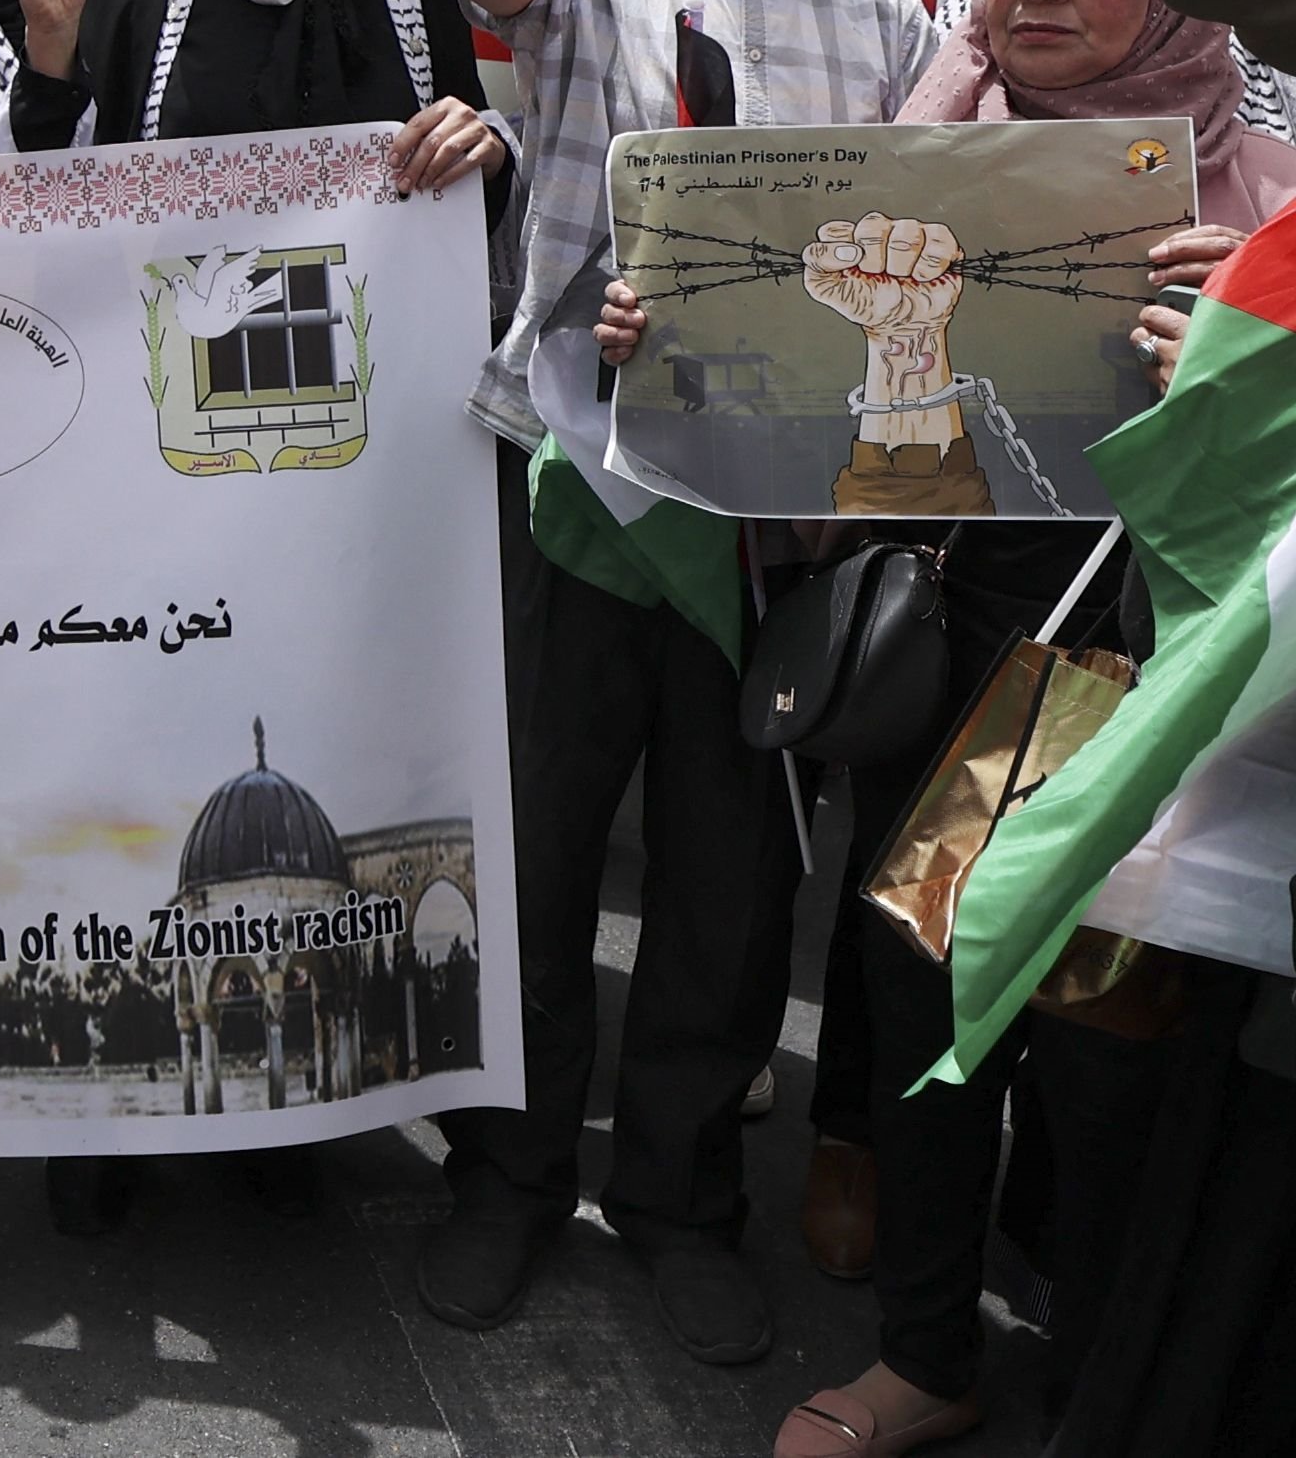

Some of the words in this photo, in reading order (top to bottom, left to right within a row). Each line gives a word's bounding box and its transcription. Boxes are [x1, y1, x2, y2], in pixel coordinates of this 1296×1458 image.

[624, 155, 650, 168] The
[653, 151, 736, 166] Palestinian
[742, 150, 829, 163] Prisoner's
[834, 148, 868, 164] Day
[676, 177, 763, 198] الفلسطيني
[825, 178, 852, 193] يوم
[26, 326, 70, 368] الهيئة
[299, 448, 342, 466] نادي
[28, 603, 149, 652] معكم
[159, 597, 233, 655] نحن
[20, 912, 58, 965] of
[73, 912, 133, 963] the
[146, 905, 281, 961] Zionist
[293, 893, 406, 949] racism
